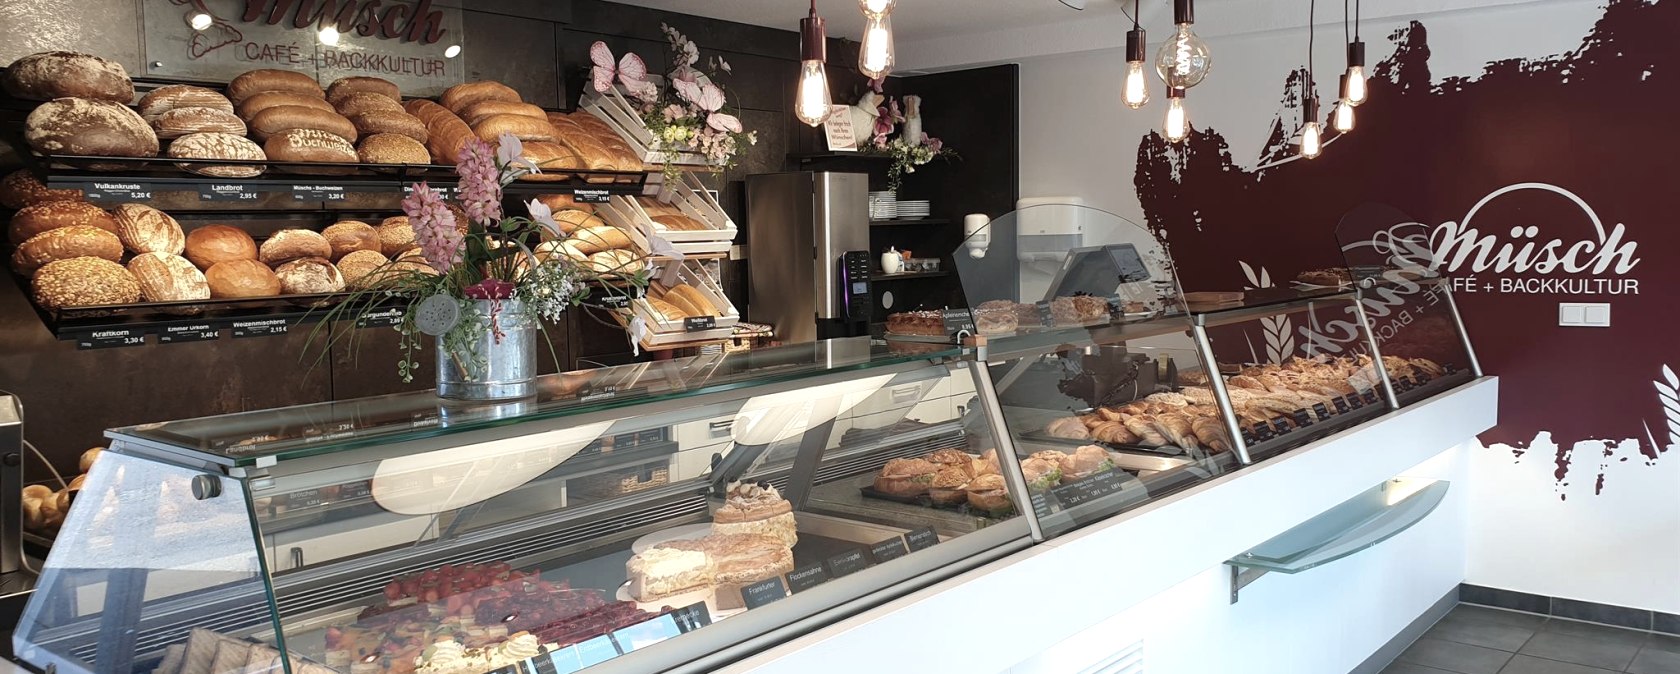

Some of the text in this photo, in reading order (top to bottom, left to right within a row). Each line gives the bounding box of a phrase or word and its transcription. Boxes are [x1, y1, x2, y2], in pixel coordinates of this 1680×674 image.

[245, 41, 300, 63] CAFÉ
[324, 50, 446, 76] BACKKULTUR
[1429, 221, 1641, 275] Müsch
[1500, 278, 1640, 295] BACKKULTUR
[232, 319, 286, 328] Weizenmischbrot
[92, 330, 130, 338] Kraftkorn
[200, 331, 213, 339] 3,40
[748, 582, 775, 595] Frankfurter
